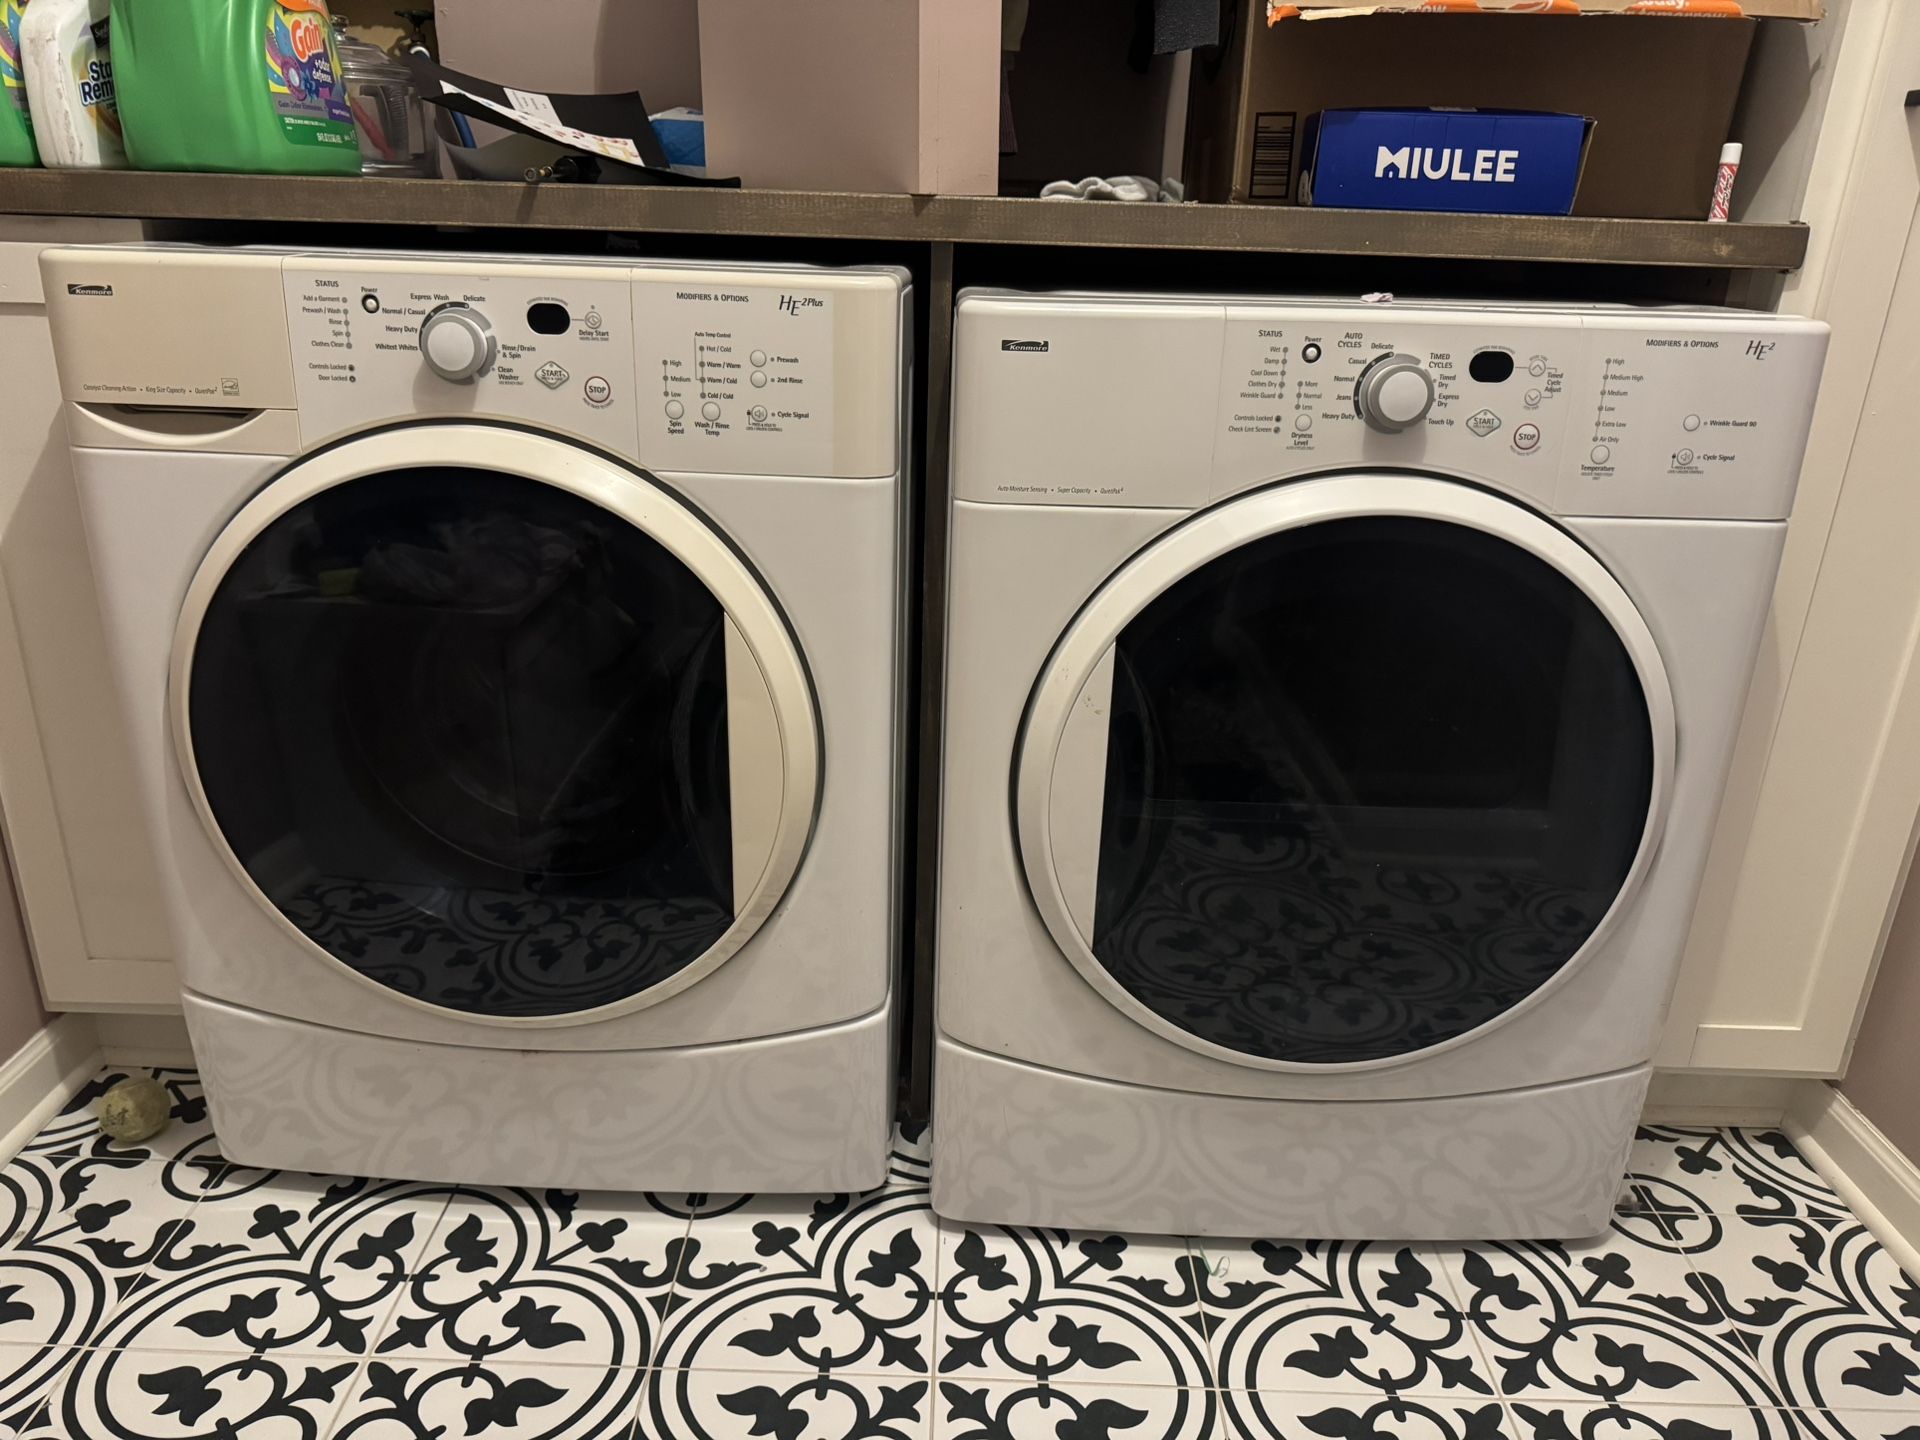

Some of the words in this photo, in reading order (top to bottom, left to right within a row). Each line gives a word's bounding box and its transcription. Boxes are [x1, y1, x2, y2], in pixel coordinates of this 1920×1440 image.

[291, 17, 323, 63] Gain
[1375, 146, 1519, 182] MIULEE
[315, 279, 339, 288] STATUS
[76, 288, 112, 296] Kenmore
[410, 293, 432, 302] Express
[433, 293, 450, 301] Wash
[676, 292, 712, 301] MODIFIERS
[721, 293, 749, 303] OPTIONS
[407, 308, 426, 316] Casual
[385, 325, 403, 334] Heavy
[404, 325, 418, 334] Duty
[579, 329, 594, 338] Delay
[595, 330, 610, 338] Start
[332, 330, 344, 338] Spin
[705, 331, 716, 339] Temp
[1259, 330, 1283, 338] STATUS
[1344, 332, 1363, 340] AUTO
[311, 340, 330, 348] Clothes
[375, 343, 398, 351] Whitest
[398, 344, 419, 352] Whites
[1337, 340, 1362, 348] CYCLES
[1371, 342, 1394, 350] Delicate
[1646, 339, 1682, 347] MODIFIERS
[1683, 340, 1689, 348] &
[1690, 340, 1719, 348] OPTIONS
[509, 352, 522, 361] Spin
[1429, 352, 1450, 360] TIMED
[308, 362, 329, 370] Controls
[1428, 361, 1453, 369] CYCLES
[1613, 358, 1625, 366] High
[498, 366, 513, 374] Clean
[541, 369, 562, 377] START
[498, 374, 520, 382] Washer
[670, 375, 691, 383] Medium
[726, 377, 737, 385] Cold
[146, 386, 156, 394] King
[588, 385, 607, 394] STOP
[777, 411, 791, 419] Cycle
[792, 412, 809, 421] Signal
[1322, 412, 1340, 420] Heavy
[1341, 412, 1355, 420] Duty
[669, 420, 682, 429] Spin
[1473, 417, 1495, 425] START
[694, 421, 710, 429] Wash
[715, 422, 730, 430] Rinse
[705, 429, 720, 437] Temp
[1291, 432, 1313, 440] Dryness
[1518, 433, 1537, 441] STOP
[1607, 436, 1620, 444] Only
[1718, 454, 1735, 462] Signal
[1581, 464, 1615, 473] Temperature
